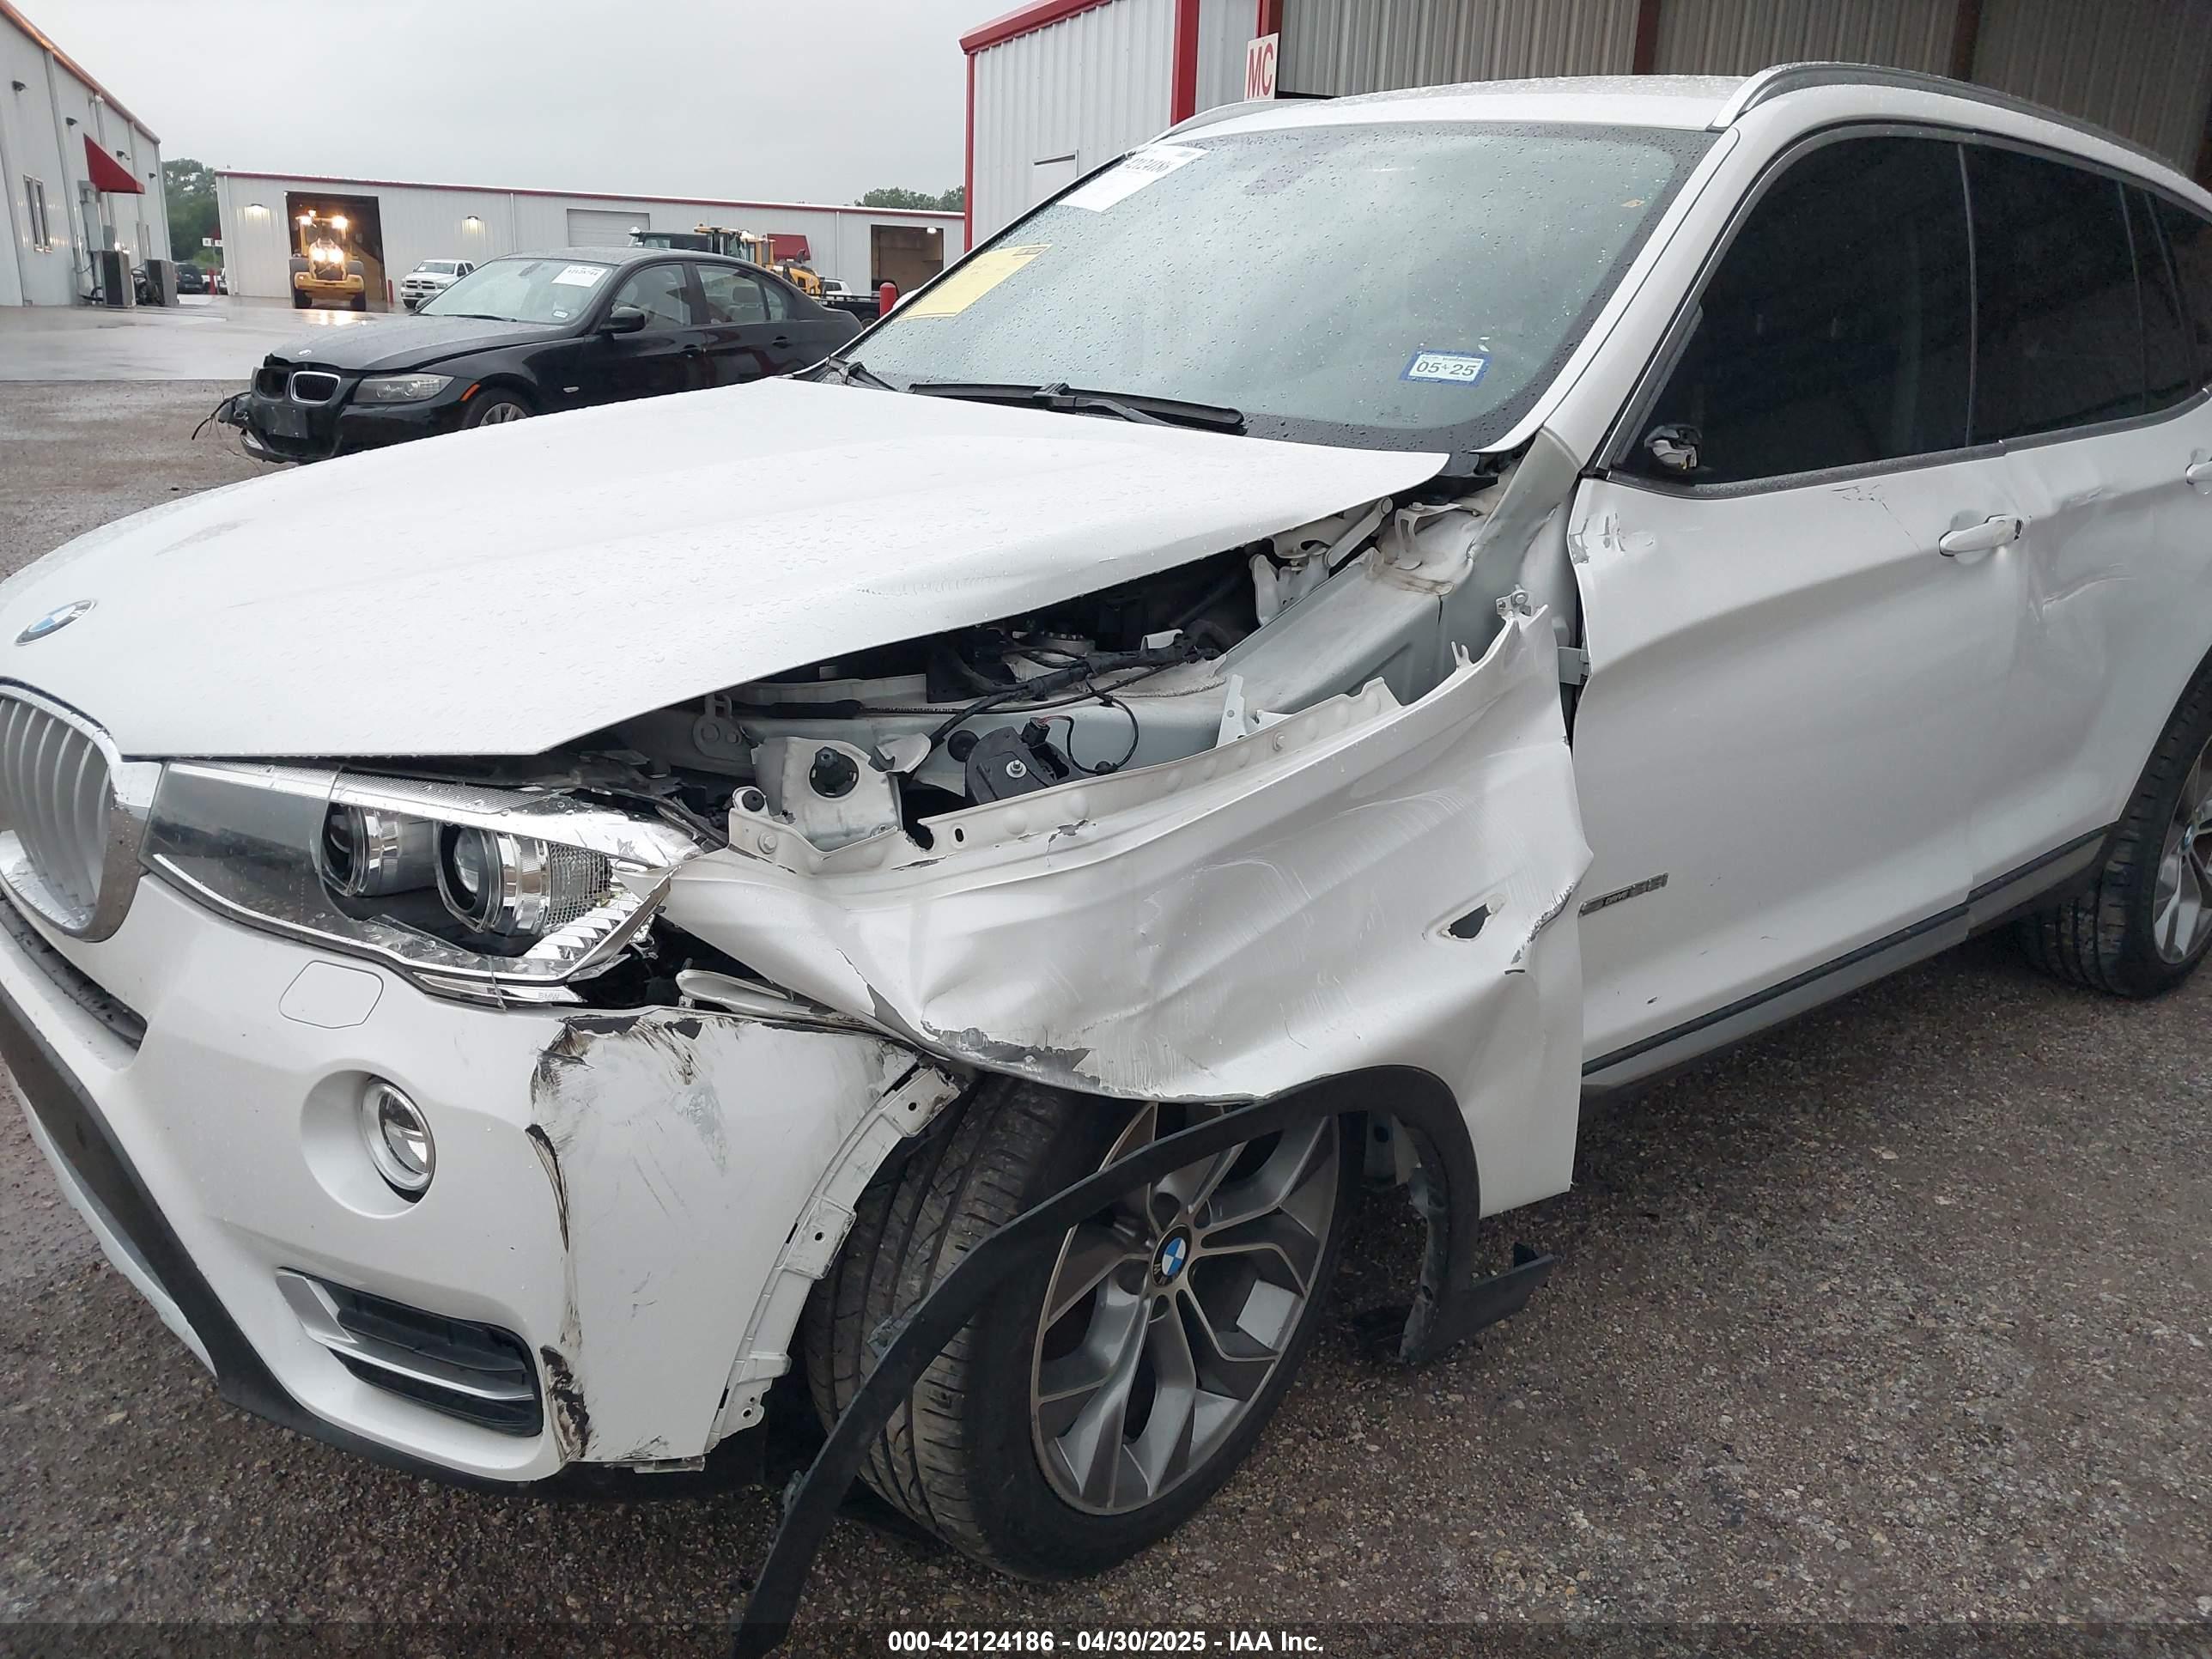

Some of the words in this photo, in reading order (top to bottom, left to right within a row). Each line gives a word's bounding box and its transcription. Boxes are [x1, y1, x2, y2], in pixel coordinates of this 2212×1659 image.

[1248, 42, 1274, 100] MC
[1416, 361, 1443, 374] 05
[1449, 363, 1477, 376] 25
